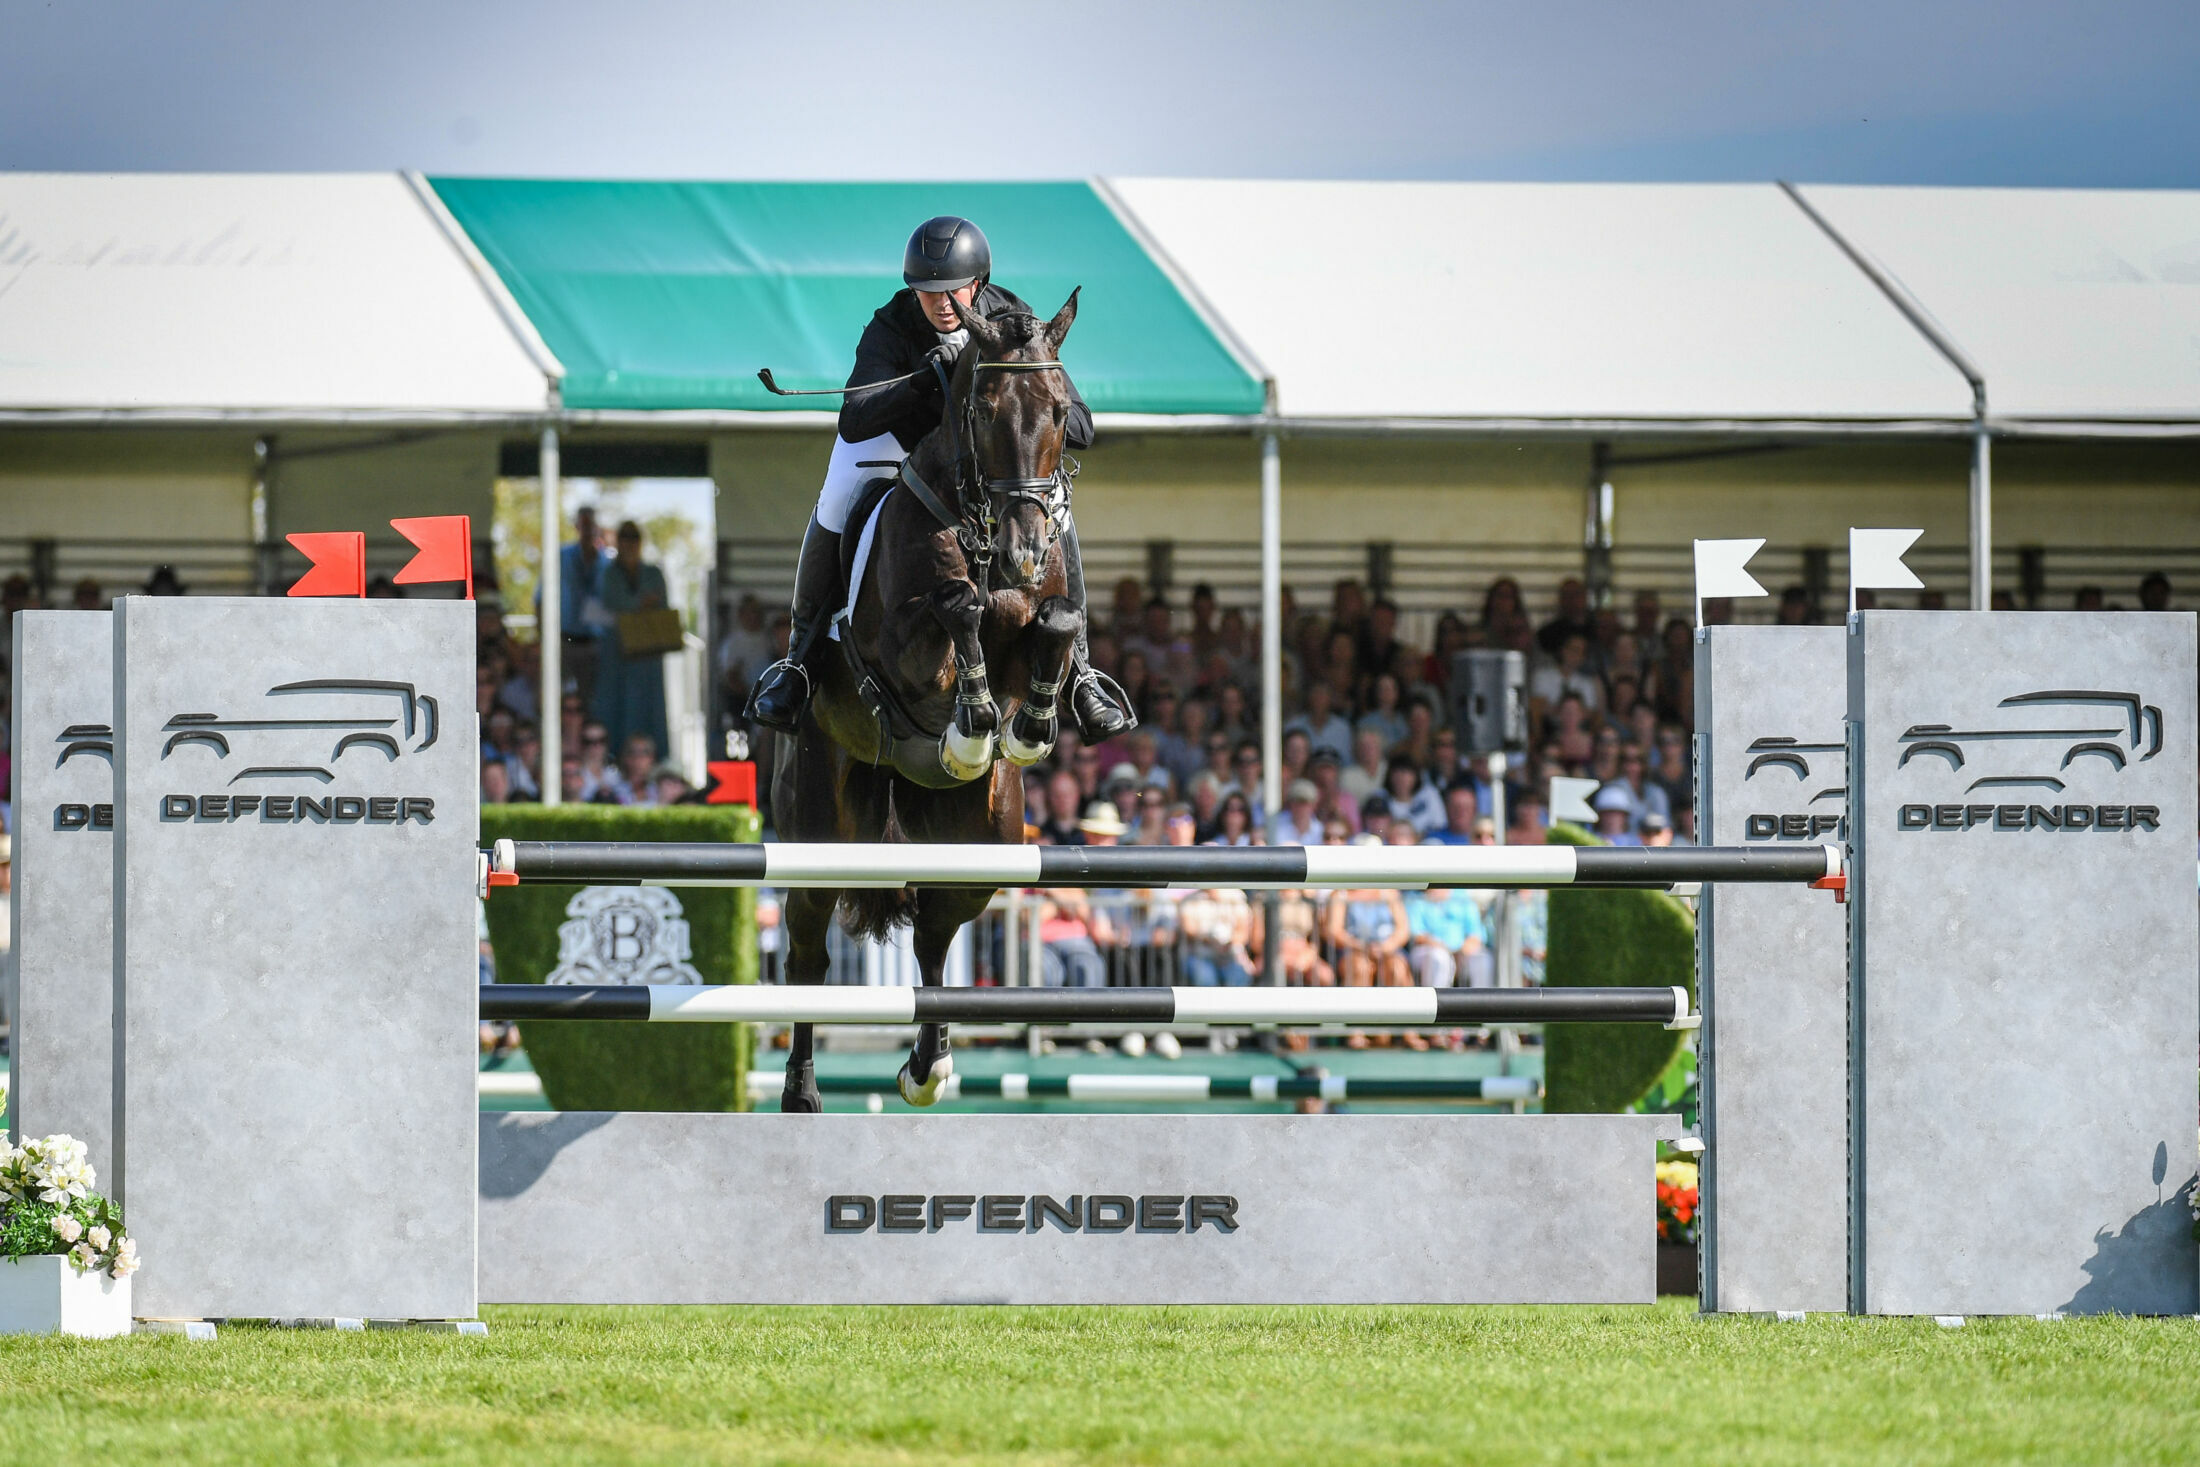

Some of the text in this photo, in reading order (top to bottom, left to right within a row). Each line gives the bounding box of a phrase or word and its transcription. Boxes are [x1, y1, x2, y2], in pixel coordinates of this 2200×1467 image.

[165, 795, 435, 821] DEFENDER
[1903, 804, 2161, 827] DEFENDER
[611, 914, 644, 960] B
[829, 1194, 1240, 1230] DEFENDER
